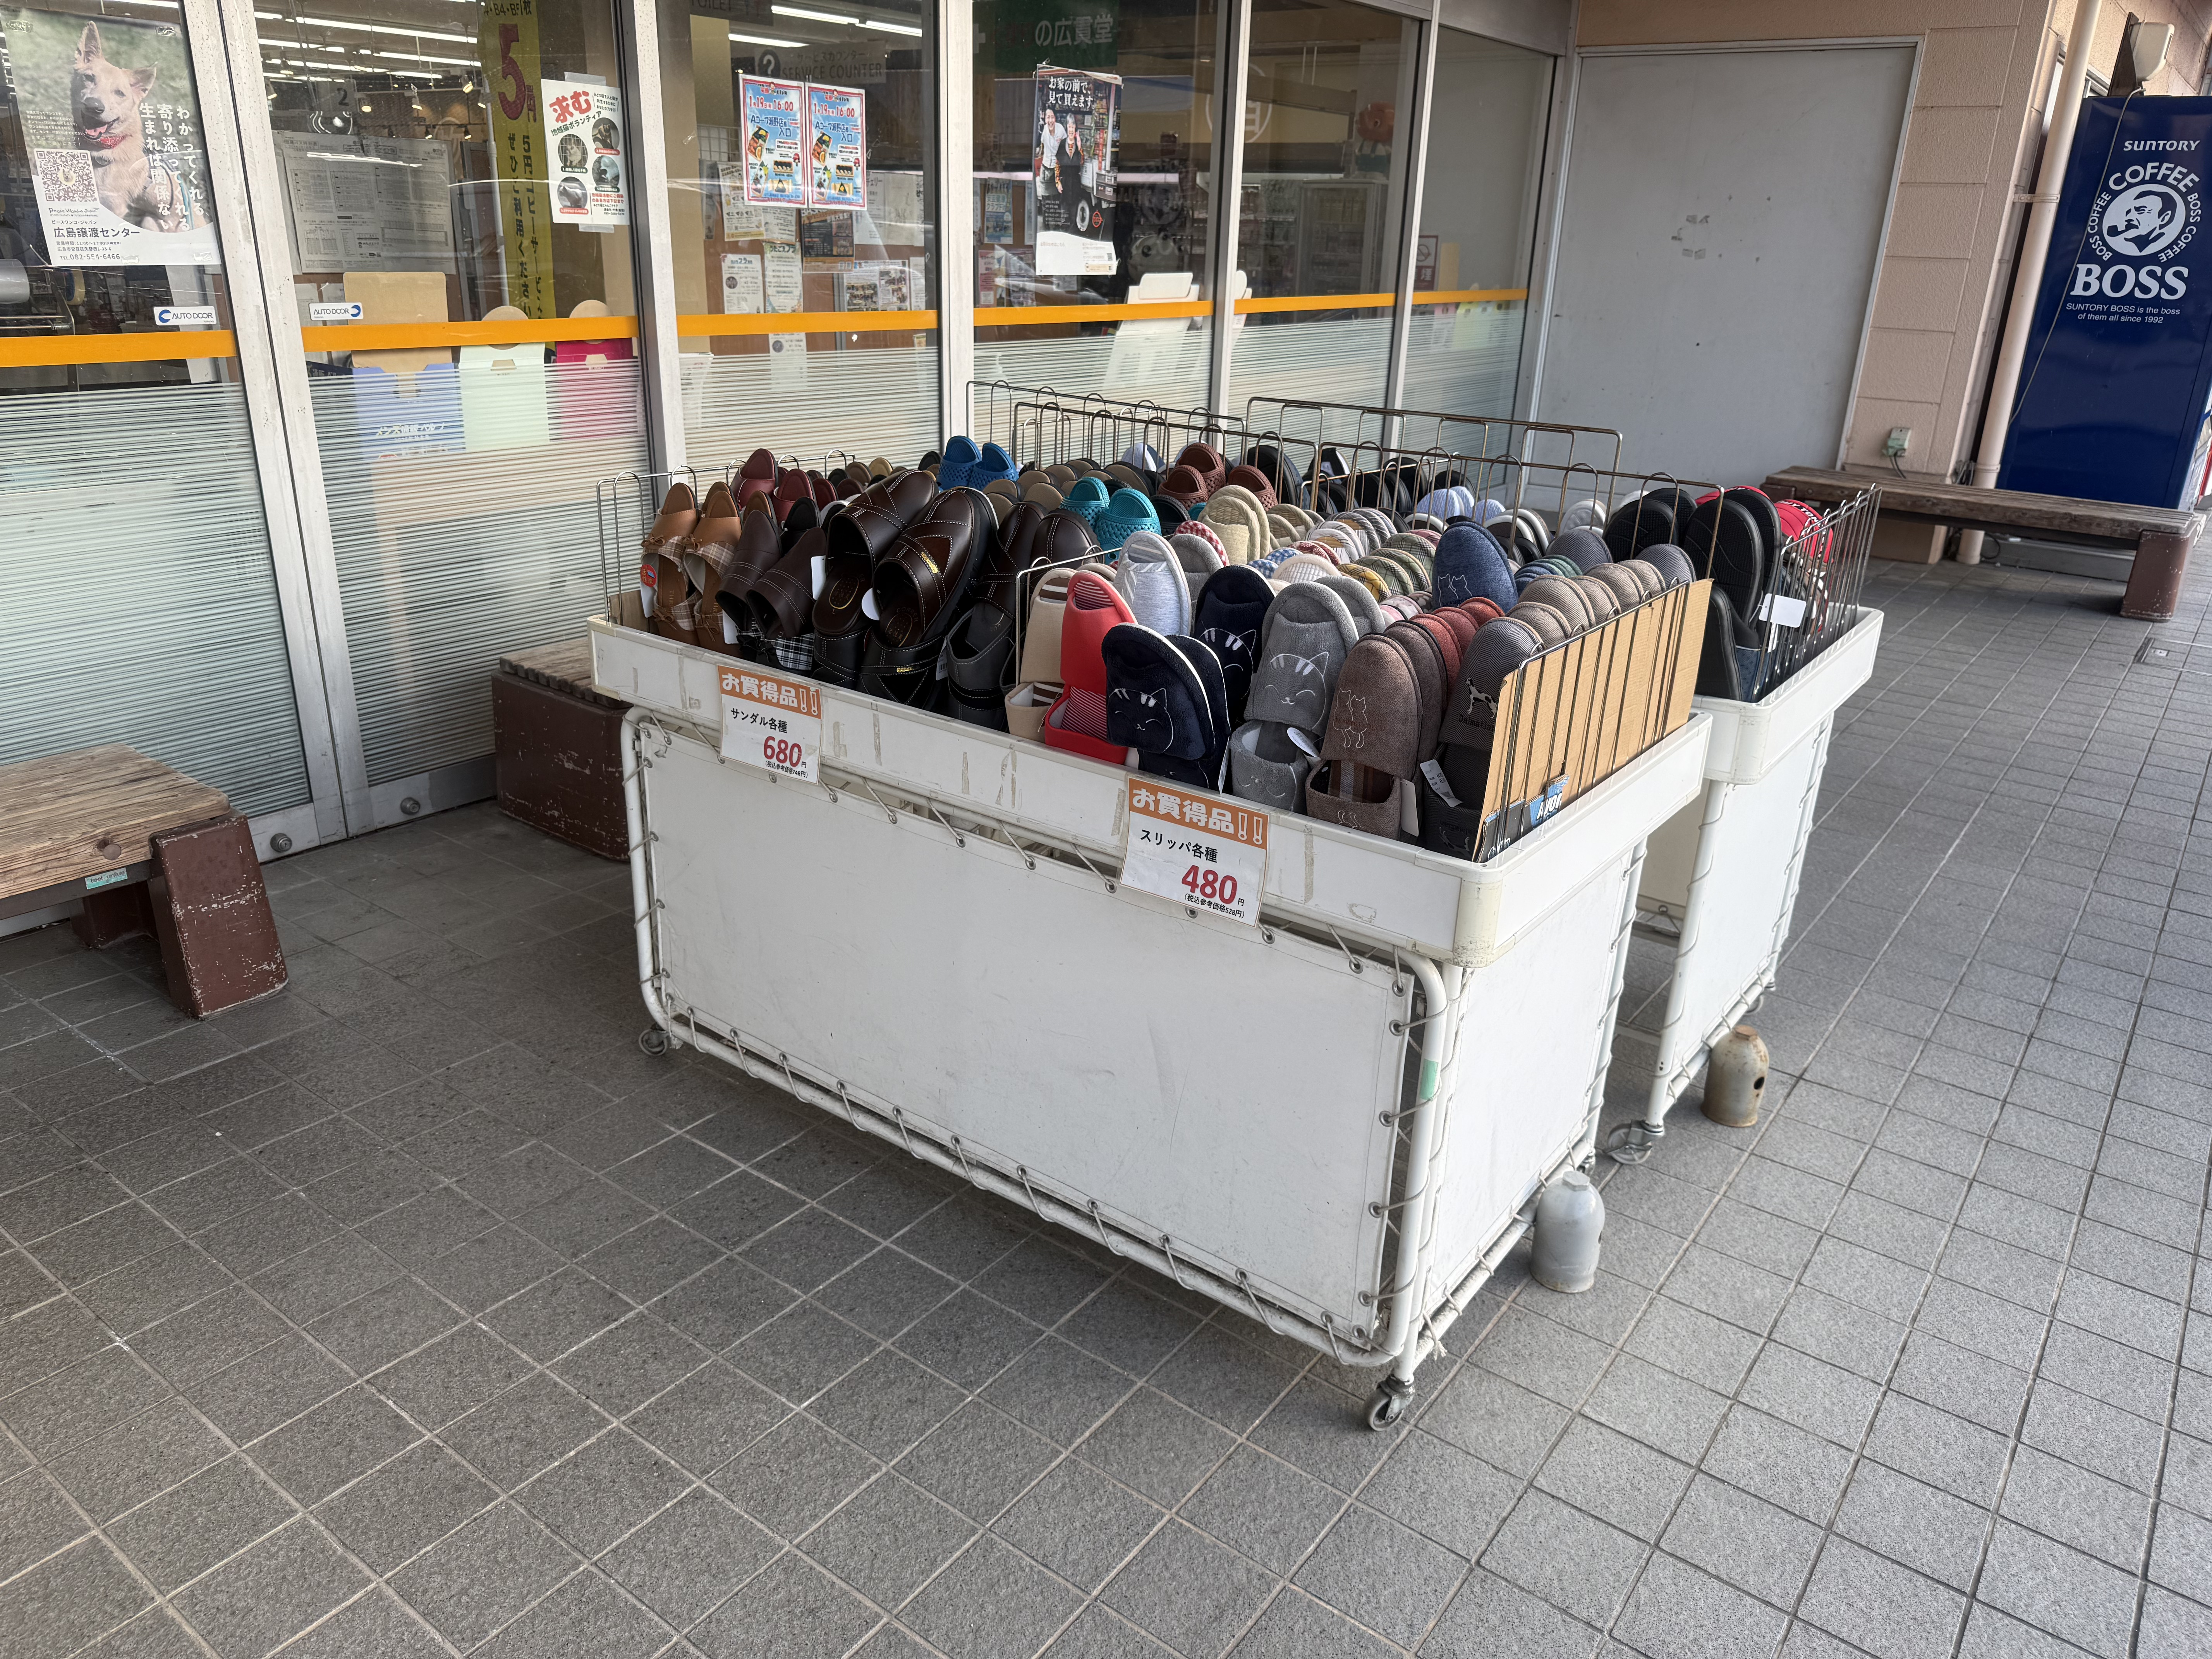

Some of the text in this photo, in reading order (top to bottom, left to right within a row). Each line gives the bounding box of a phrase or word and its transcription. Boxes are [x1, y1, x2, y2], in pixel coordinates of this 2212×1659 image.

[830, 63, 882, 77] COUNTER
[1049, 76, 1091, 94] お家の前で、
[549, 91, 591, 123] 求む
[773, 100, 793, 112] 16:00
[836, 106, 855, 117] 16:00
[1048, 91, 1095, 109] 見て買えます。
[779, 127, 791, 137] 入口
[2123, 140, 2200, 151] SUNTORY
[139, 103, 173, 230] 生まれは関係ない
[156, 103, 190, 231] 寄り添ってくれる
[2109, 162, 2200, 192] COFFEE
[53, 227, 140, 238] 広島譲渡センター
[2088, 192, 2113, 261] BOSS COFFEE
[2158, 192, 2201, 263] BOSS COFFEE
[2070, 264, 2189, 300] BOSS
[2066, 303, 2109, 312] SUNTORY
[2110, 304, 2135, 313] BOSS
[731, 708, 788, 733] サンダル各種
[1140, 829, 1218, 863] スリッパ各種
[1185, 893, 1245, 919] (税込参考価格528円)
